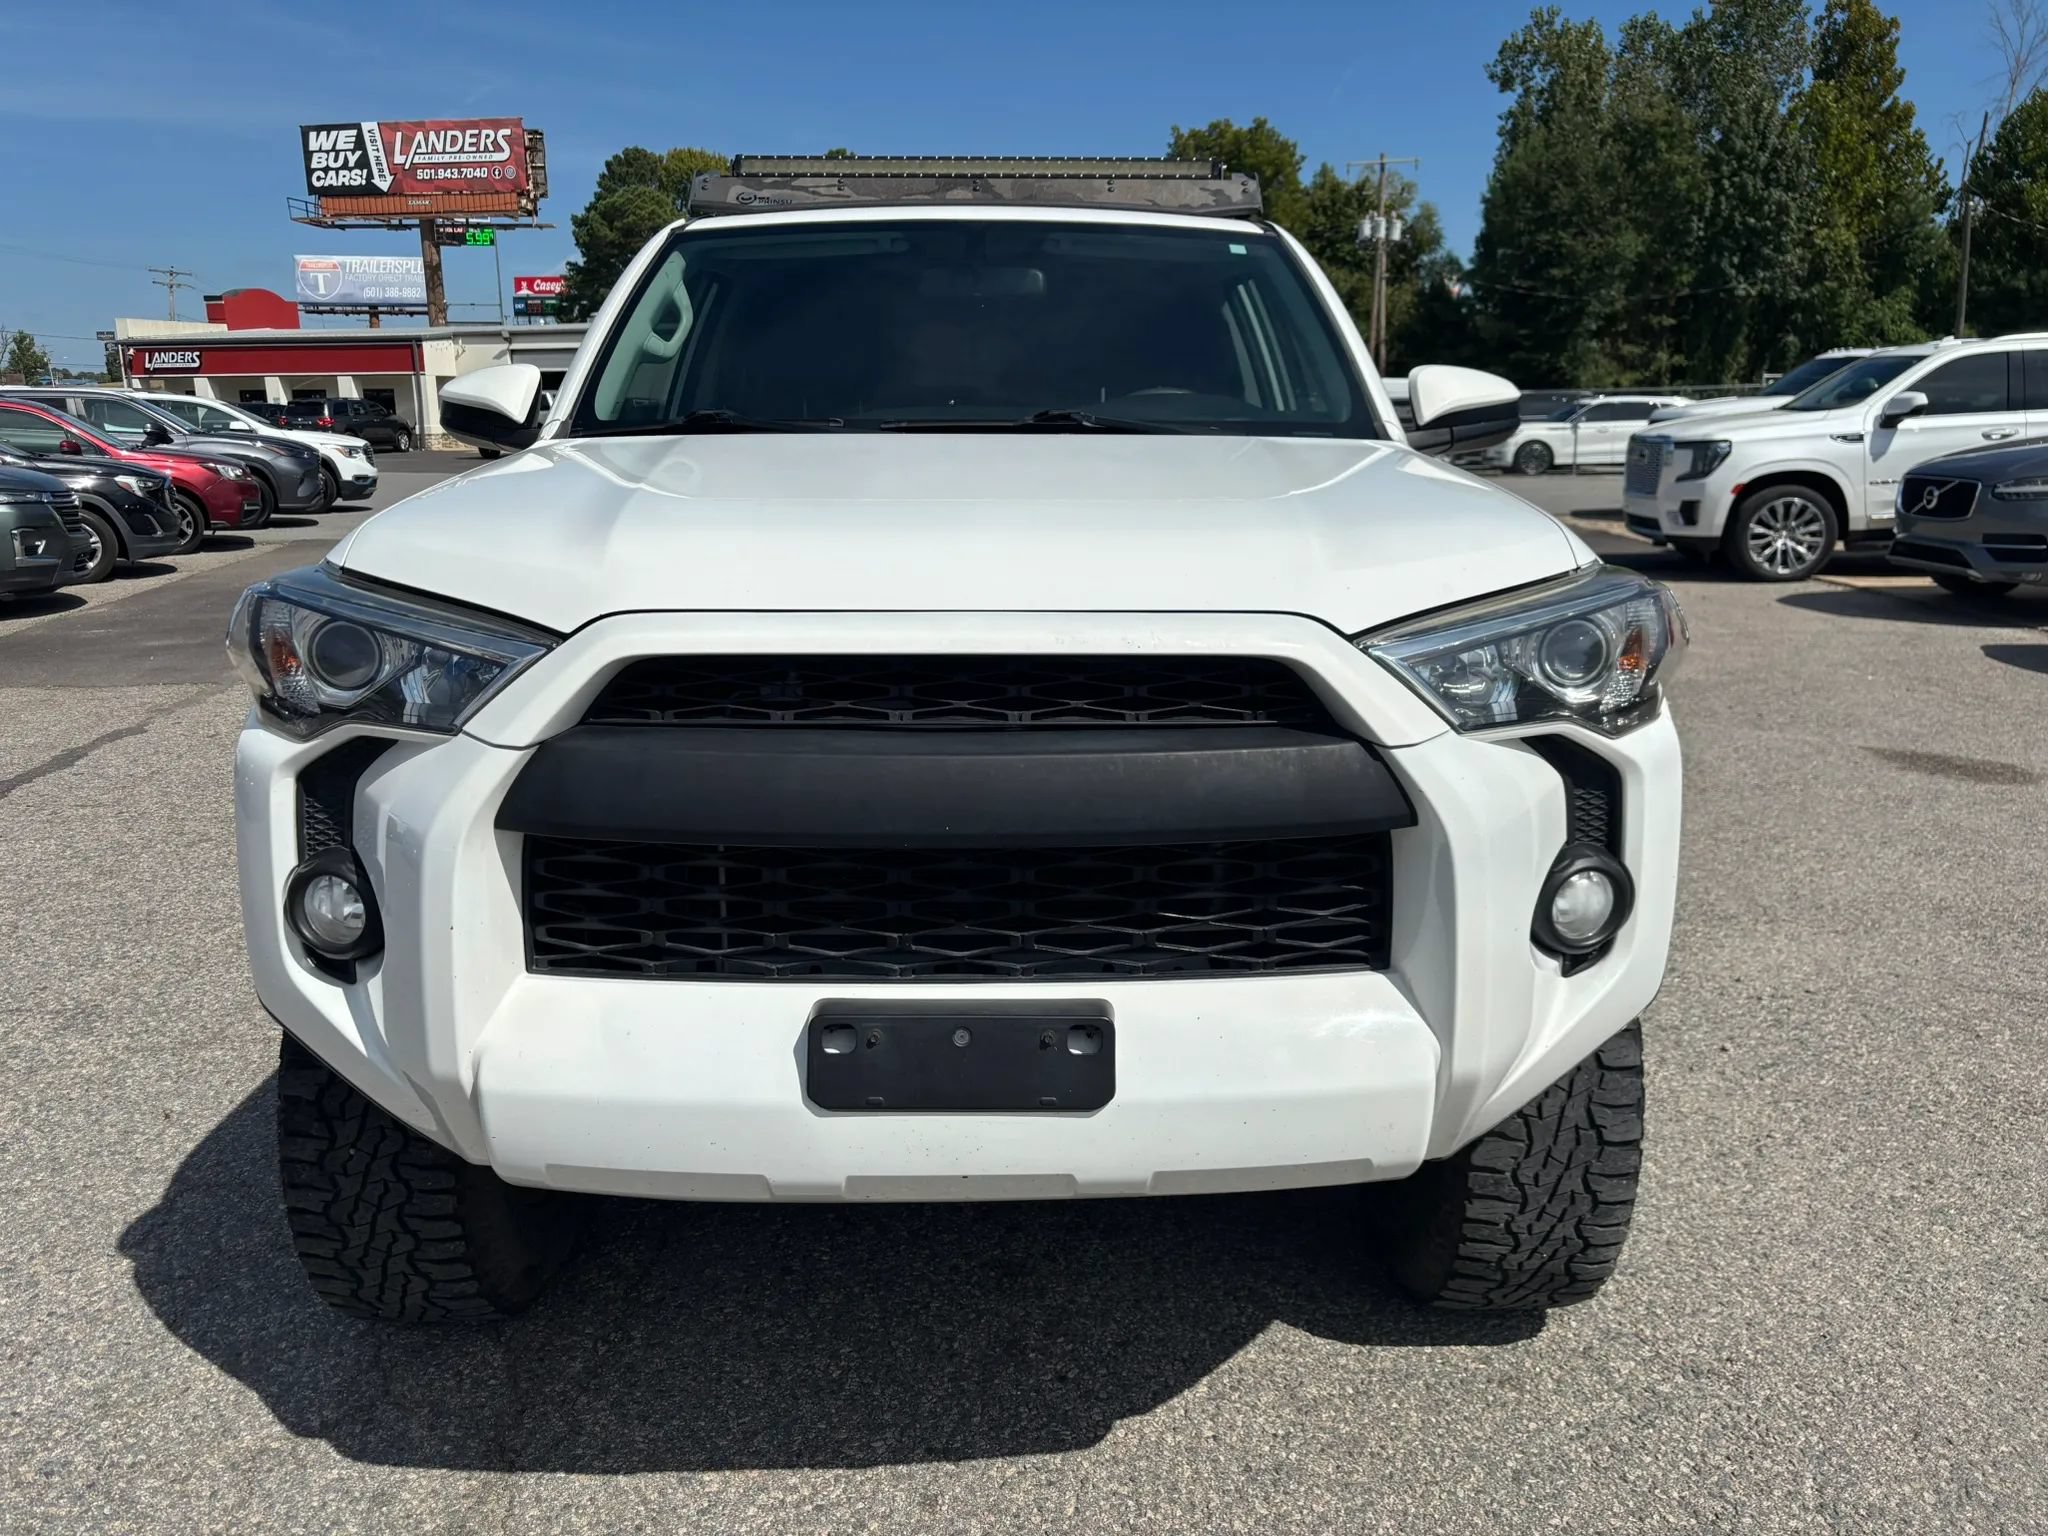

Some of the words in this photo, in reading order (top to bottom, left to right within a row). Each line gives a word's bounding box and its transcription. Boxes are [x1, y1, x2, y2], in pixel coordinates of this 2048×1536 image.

[308, 129, 358, 151] WE
[367, 128, 380, 153] VISIT
[394, 128, 512, 169] LANDERS
[311, 150, 363, 169] BUY
[373, 155, 388, 182] HERE!
[311, 169, 368, 188] CARS!
[416, 167, 488, 180] 501.943.7040
[343, 260, 425, 274] TRAILERSPLU
[310, 273, 331, 295] T
[344, 273, 377, 282] FACTORY
[145, 351, 200, 371] LANDERS
